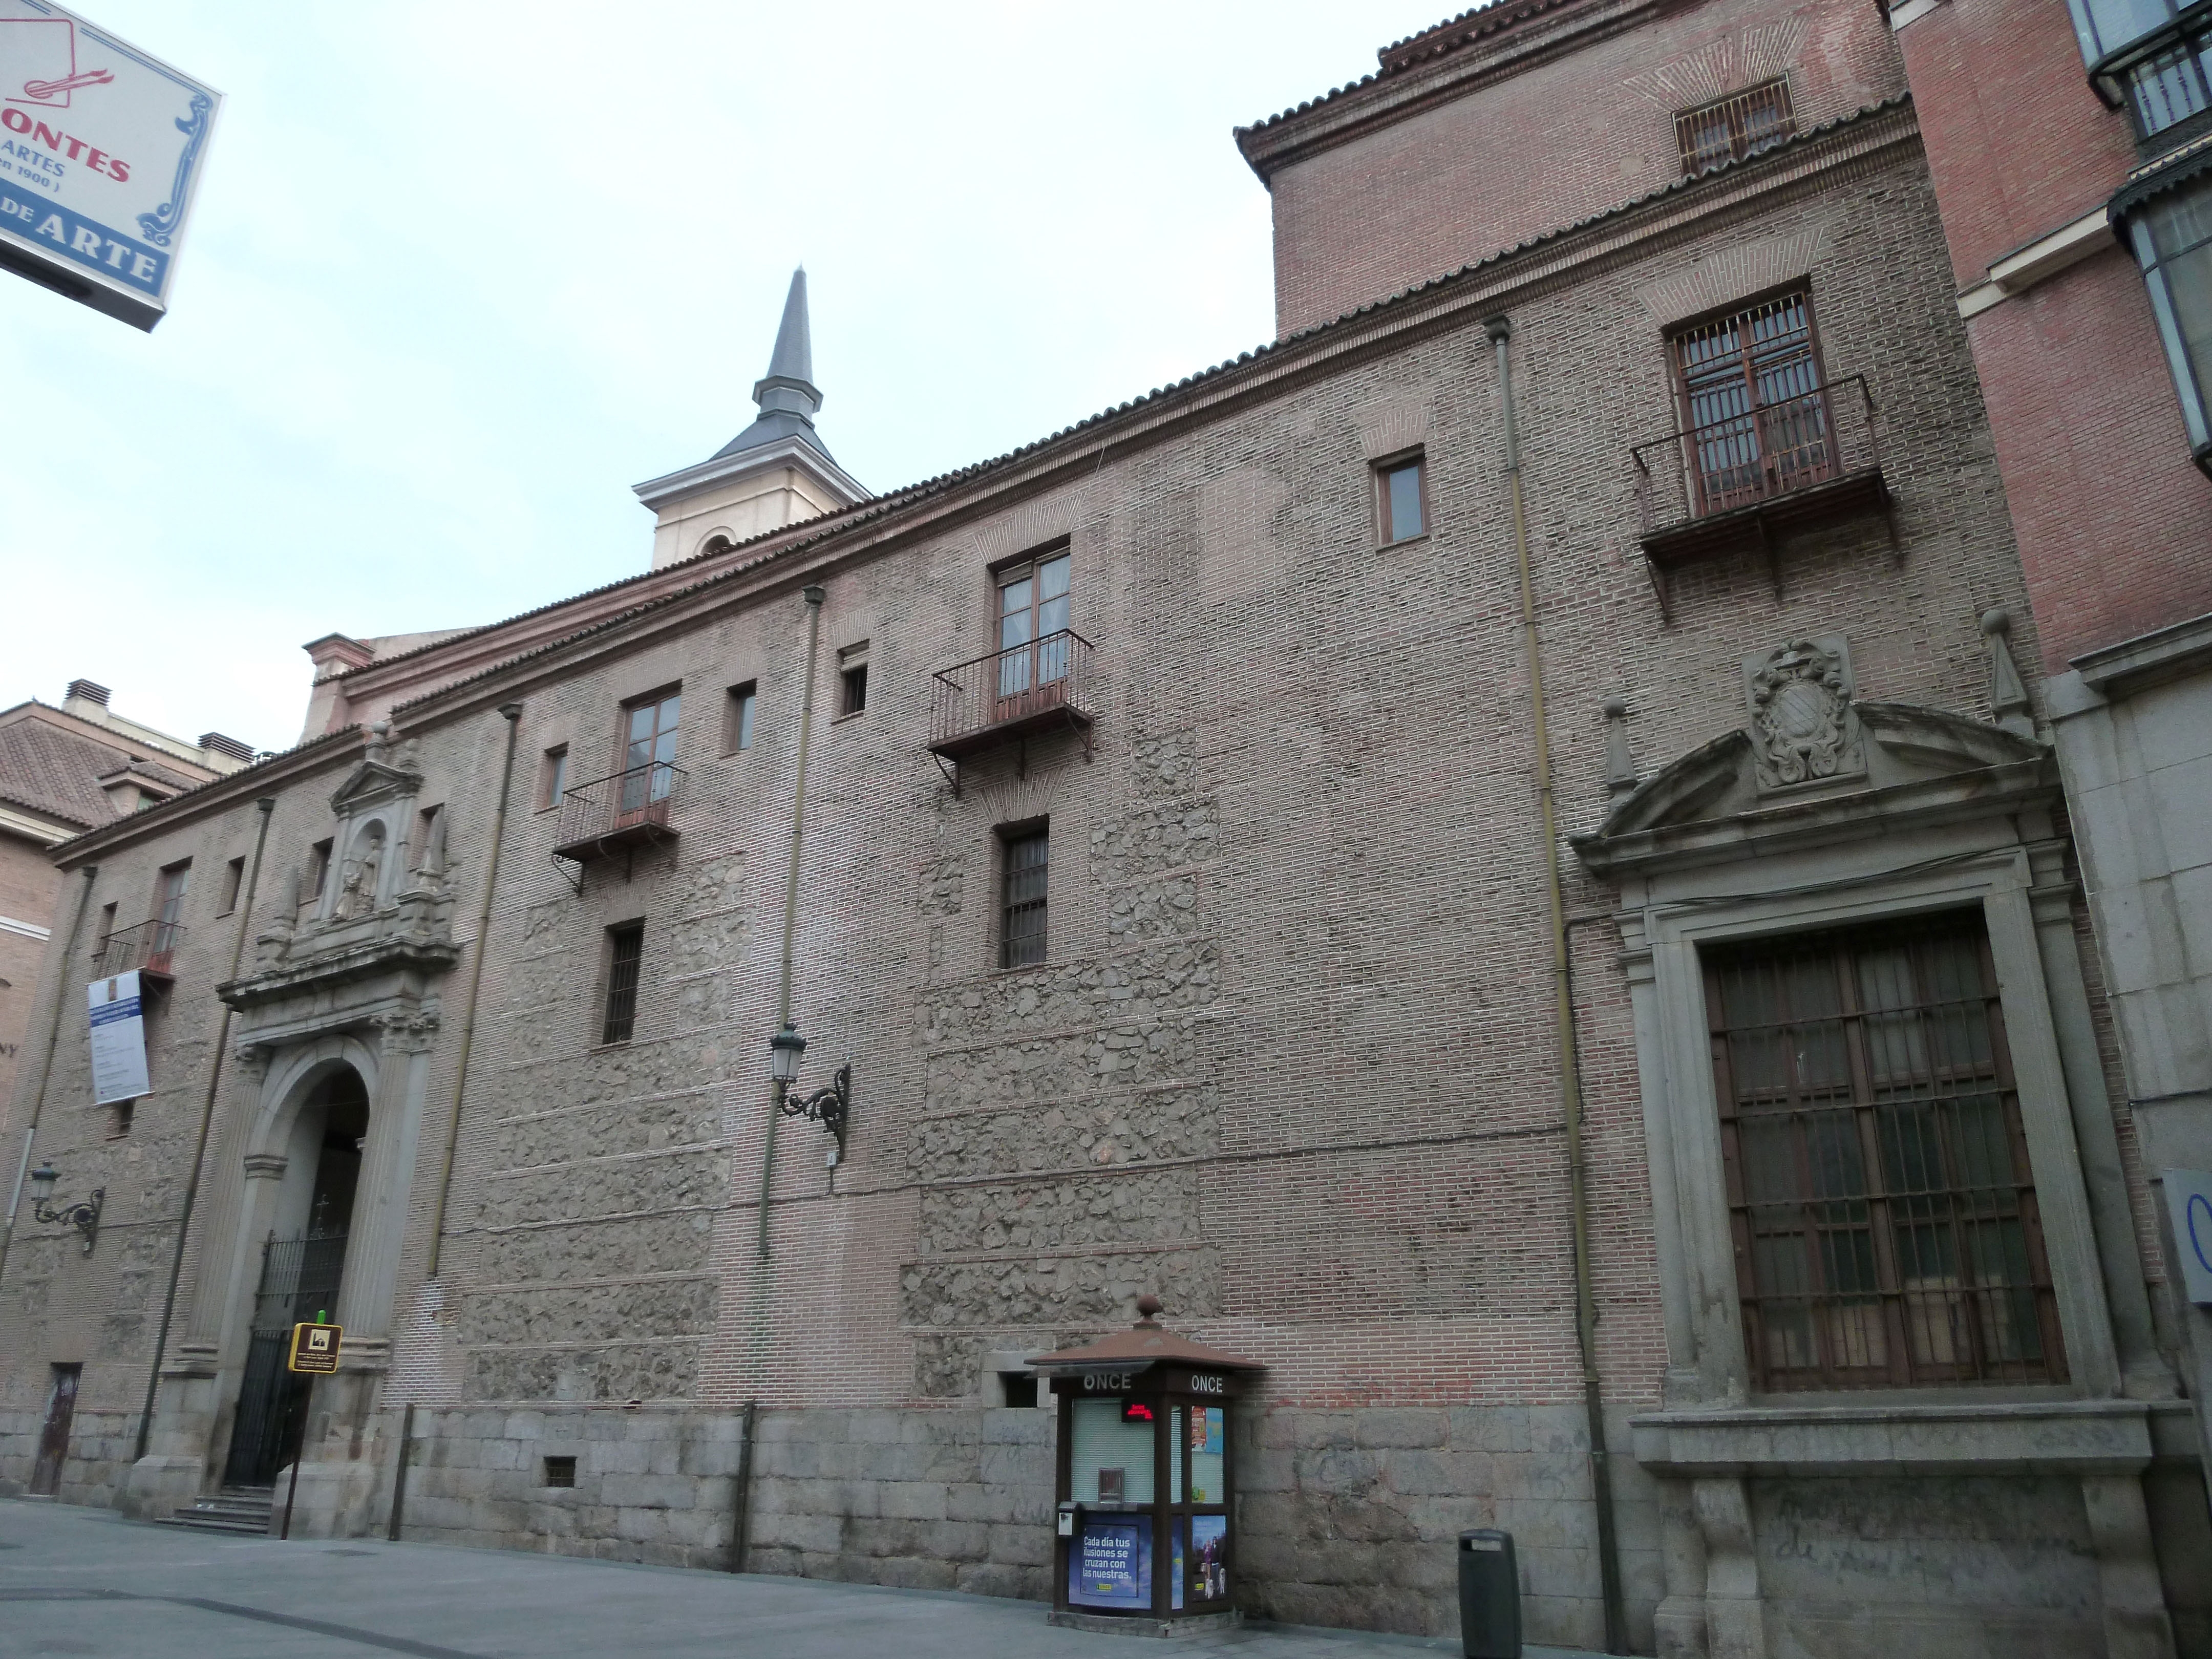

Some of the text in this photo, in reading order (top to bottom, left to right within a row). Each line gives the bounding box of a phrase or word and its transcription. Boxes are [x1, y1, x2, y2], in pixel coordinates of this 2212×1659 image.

[2, 108, 130, 182] ONTES
[1, 139, 65, 177] ARTES
[18, 165, 50, 187] 1900
[1, 197, 157, 283] DE ARTE
[1084, 1373, 1131, 1389] ONCE
[1192, 1374, 1223, 1392] ONCE
[1084, 1536, 1130, 1547] Cada día tus
[1083, 1547, 1115, 1557] ilusiones
[1085, 1559, 1125, 1568] cruzan con
[1083, 1568, 1132, 1579] las nuestras.
